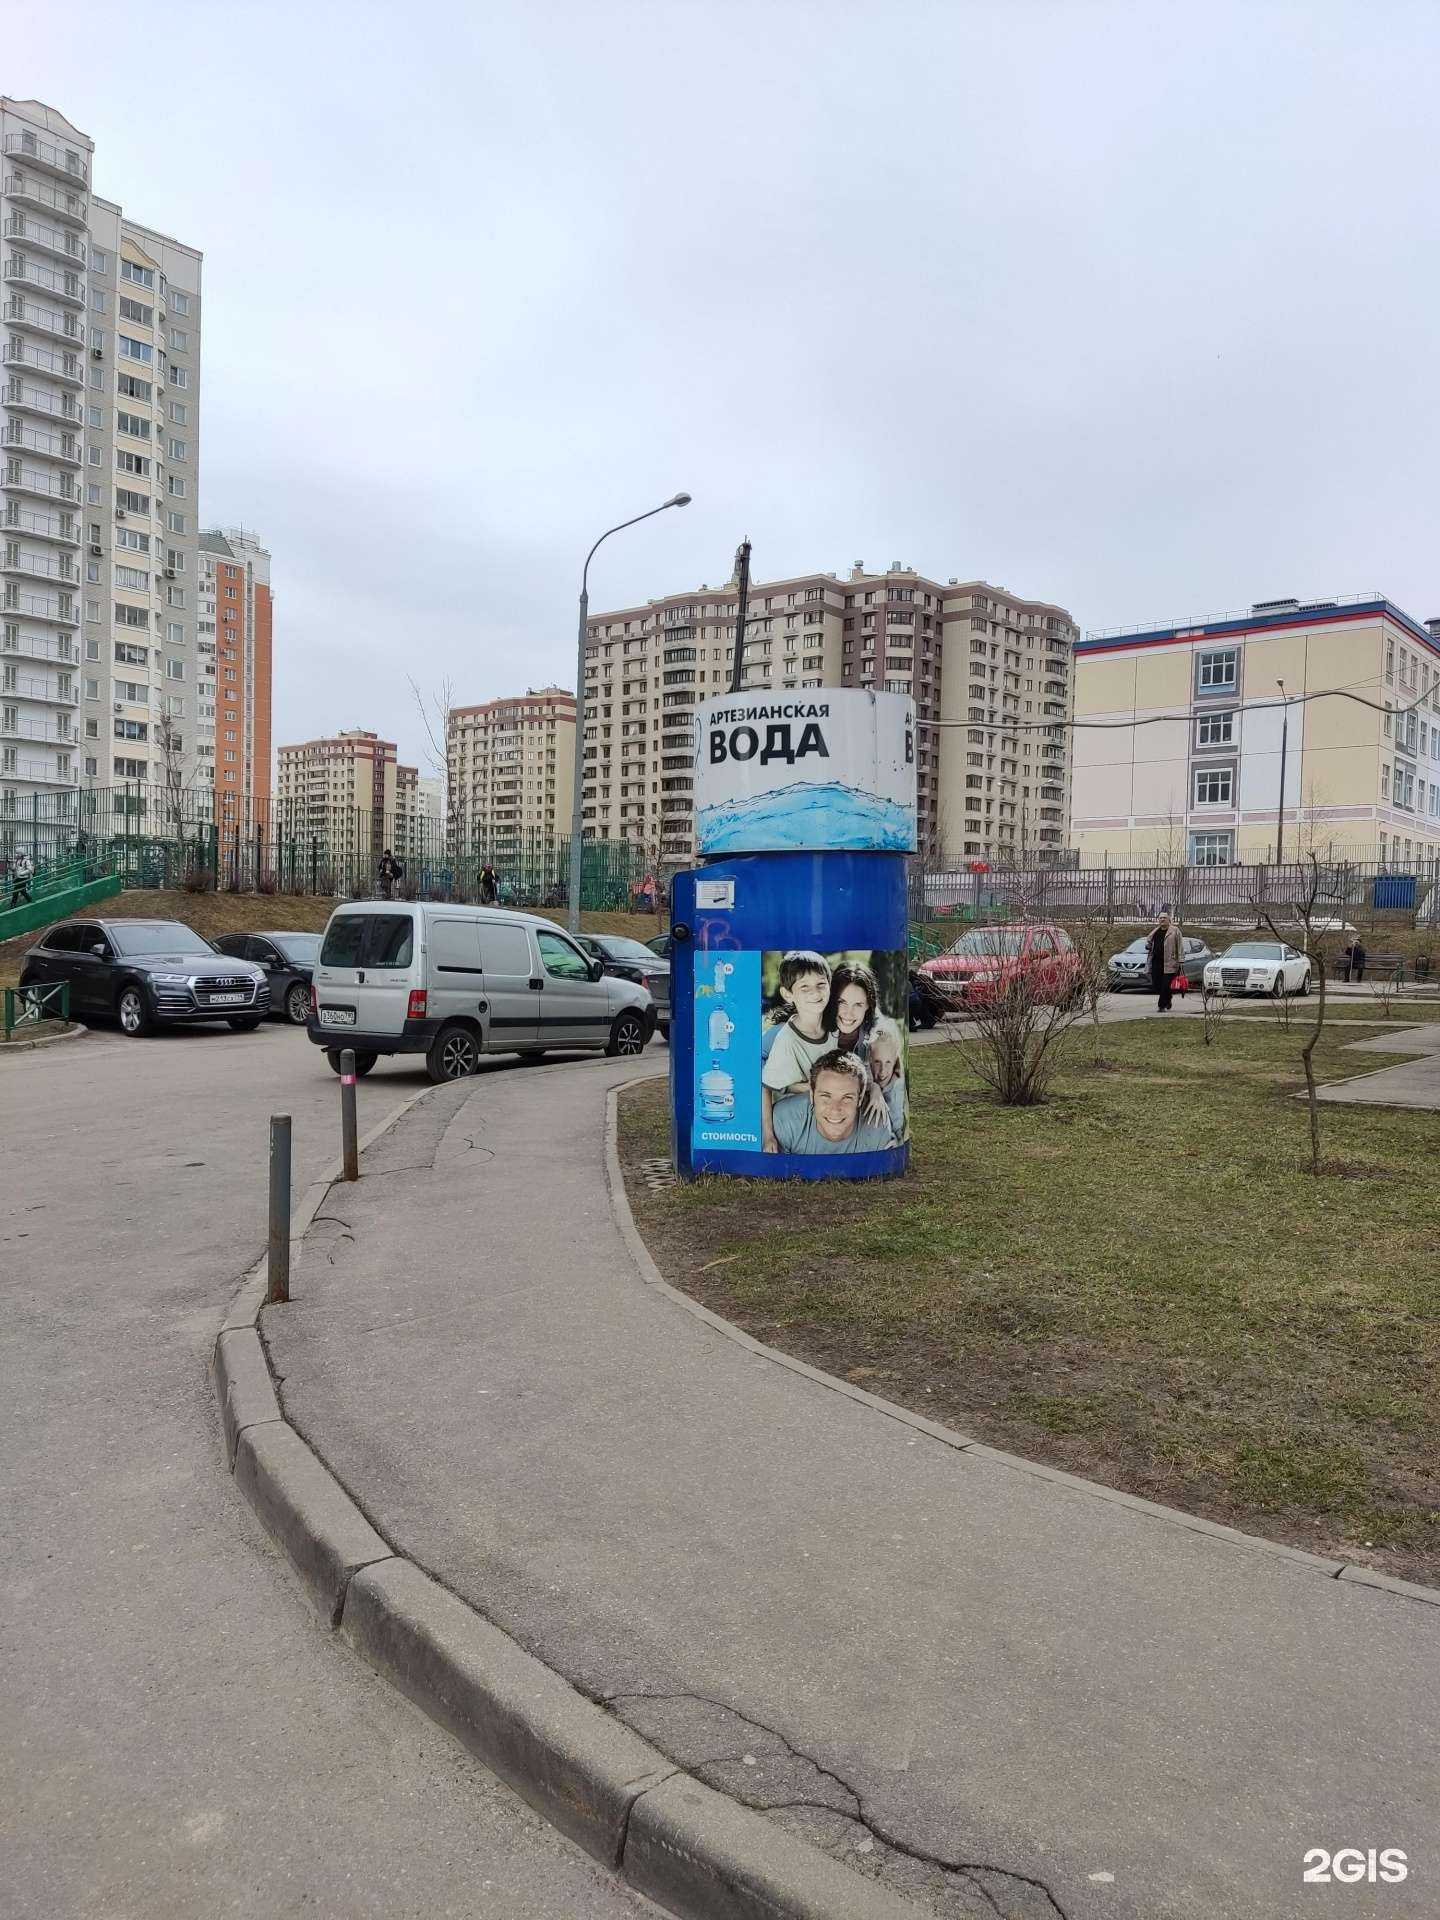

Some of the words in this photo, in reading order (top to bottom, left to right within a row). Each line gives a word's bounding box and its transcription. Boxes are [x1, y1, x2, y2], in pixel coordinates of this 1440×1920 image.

[710, 704, 829, 726] АРТЕЗИАНСКАЯ
[710, 723, 830, 765] ВОДА
[701, 1132, 758, 1142] СТОИМОСТЬ
